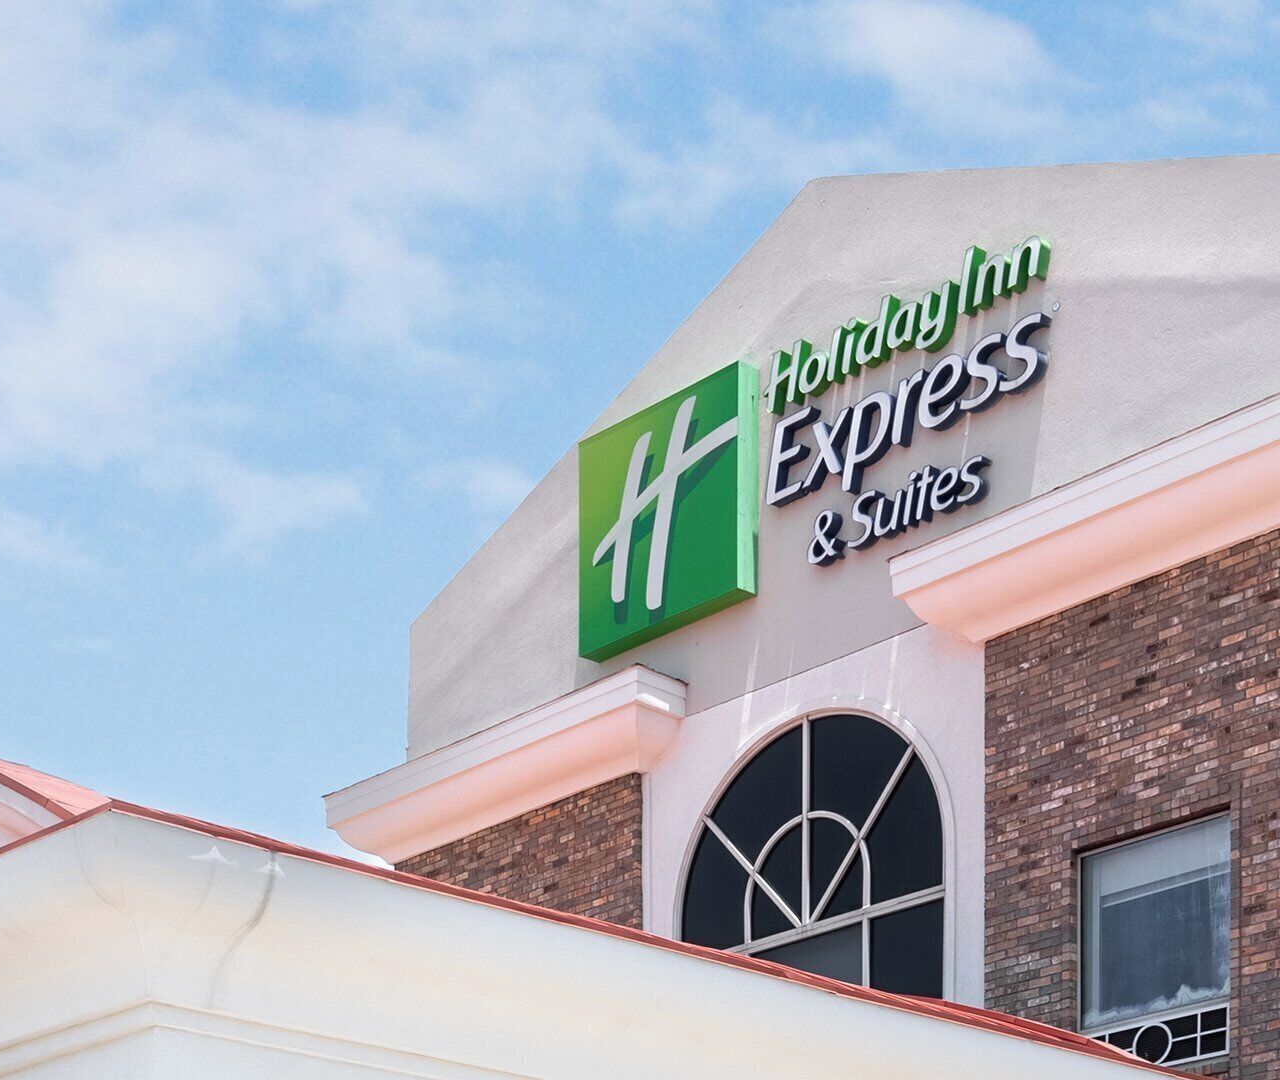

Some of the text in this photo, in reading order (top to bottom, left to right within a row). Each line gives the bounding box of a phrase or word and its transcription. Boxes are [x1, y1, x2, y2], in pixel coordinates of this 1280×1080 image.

[764, 235, 1050, 415] Holiday Inn
[766, 312, 1051, 507] Express
[592, 395, 738, 611] H
[807, 455, 991, 566] & Suites
